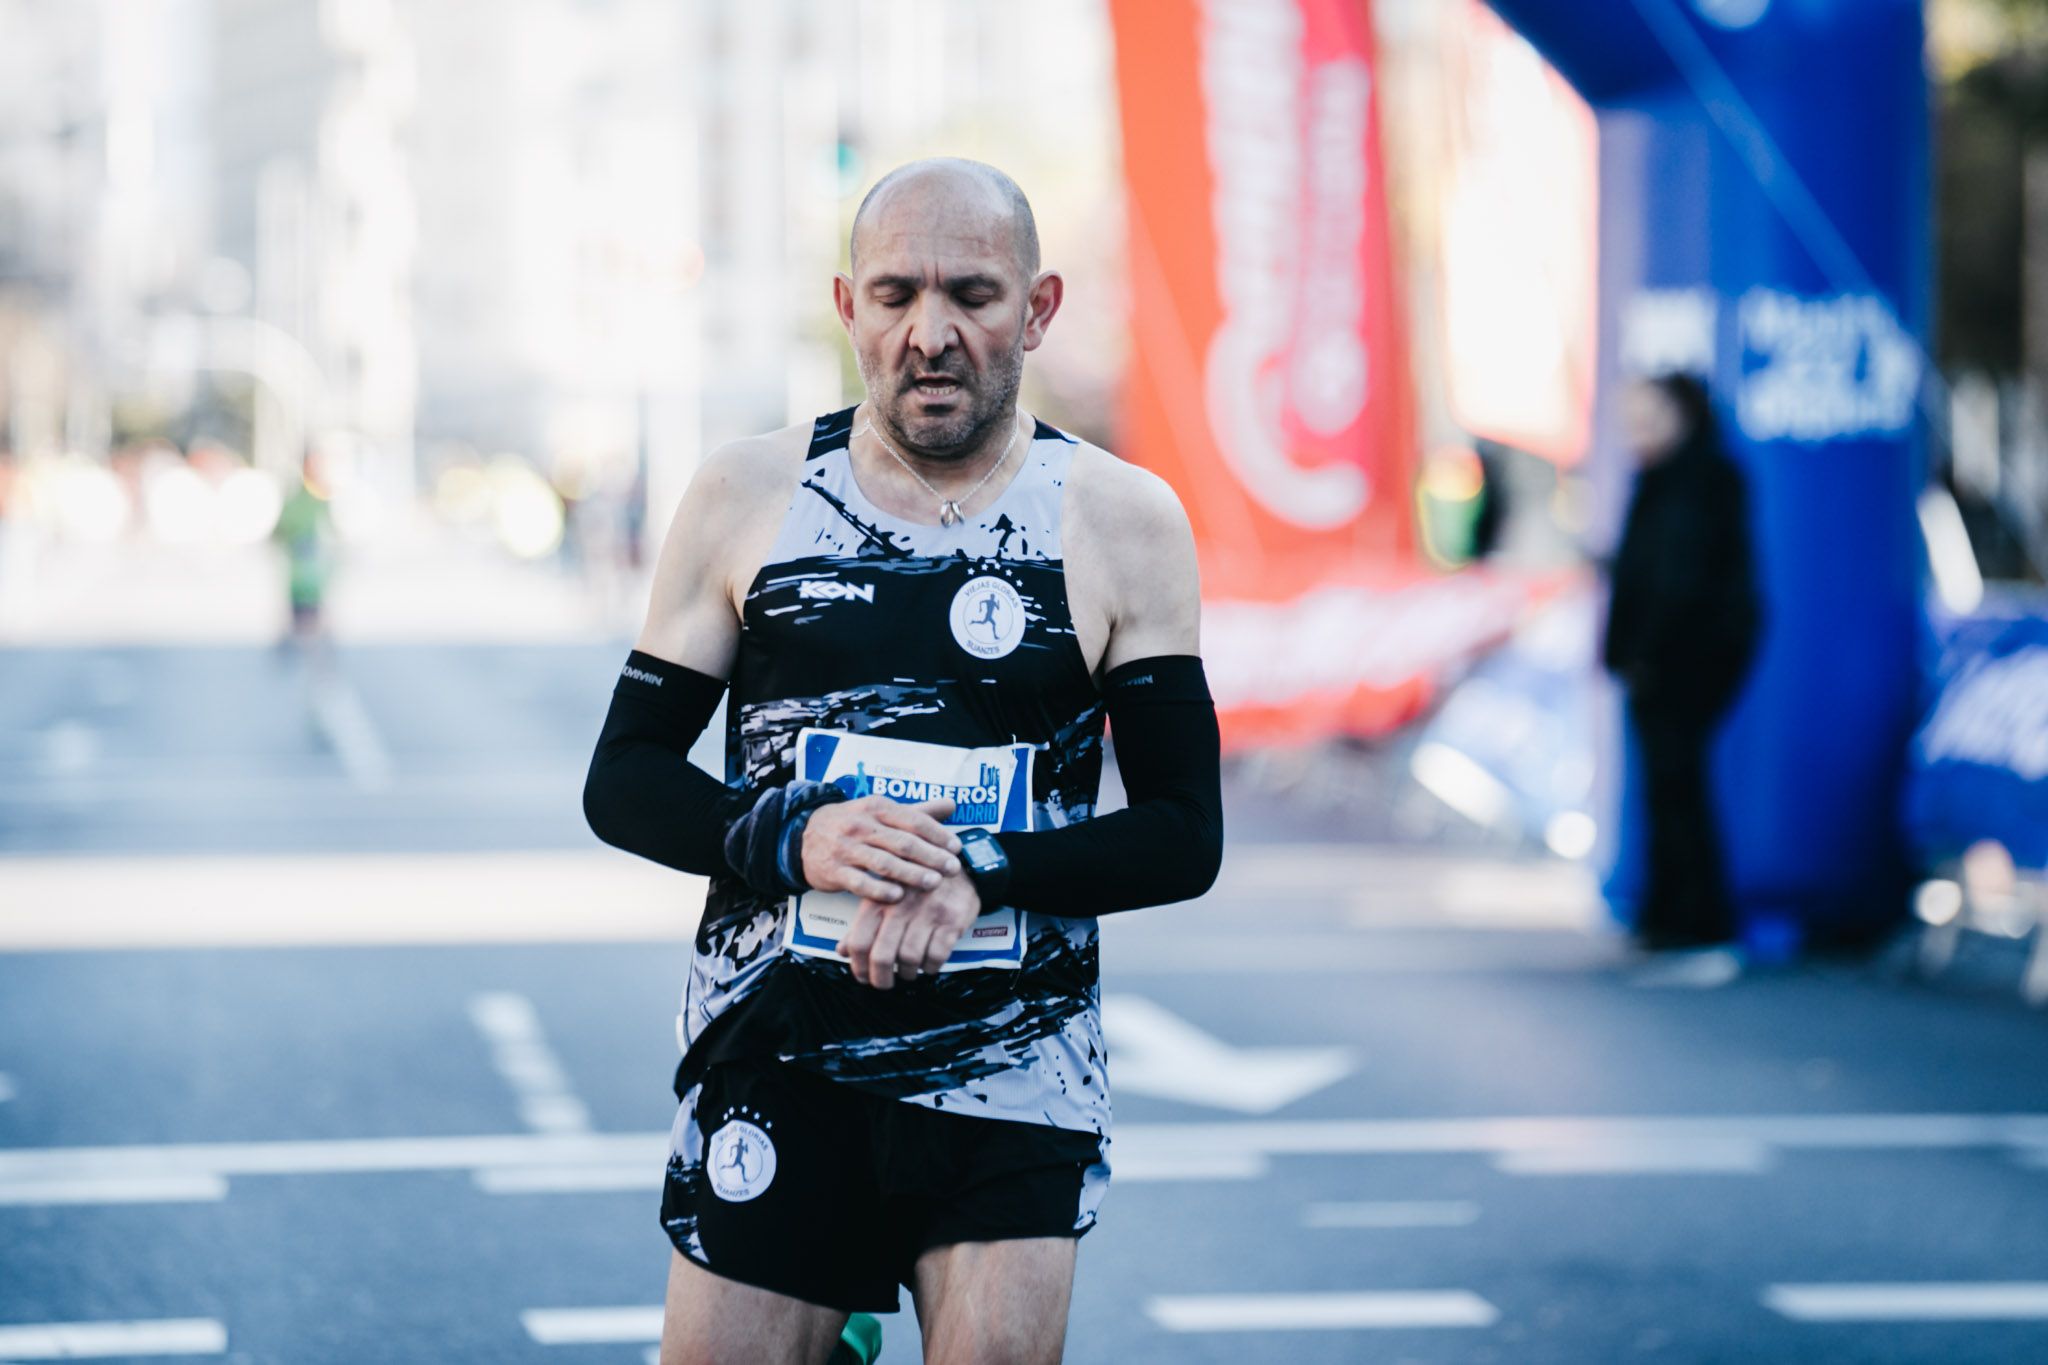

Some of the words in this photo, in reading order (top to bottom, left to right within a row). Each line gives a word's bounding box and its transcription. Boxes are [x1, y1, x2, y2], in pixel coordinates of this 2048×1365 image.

[991, 581, 1019, 609] GLORIAS
[872, 776, 998, 804] BOMBEROS
[952, 804, 997, 823] ADRID
